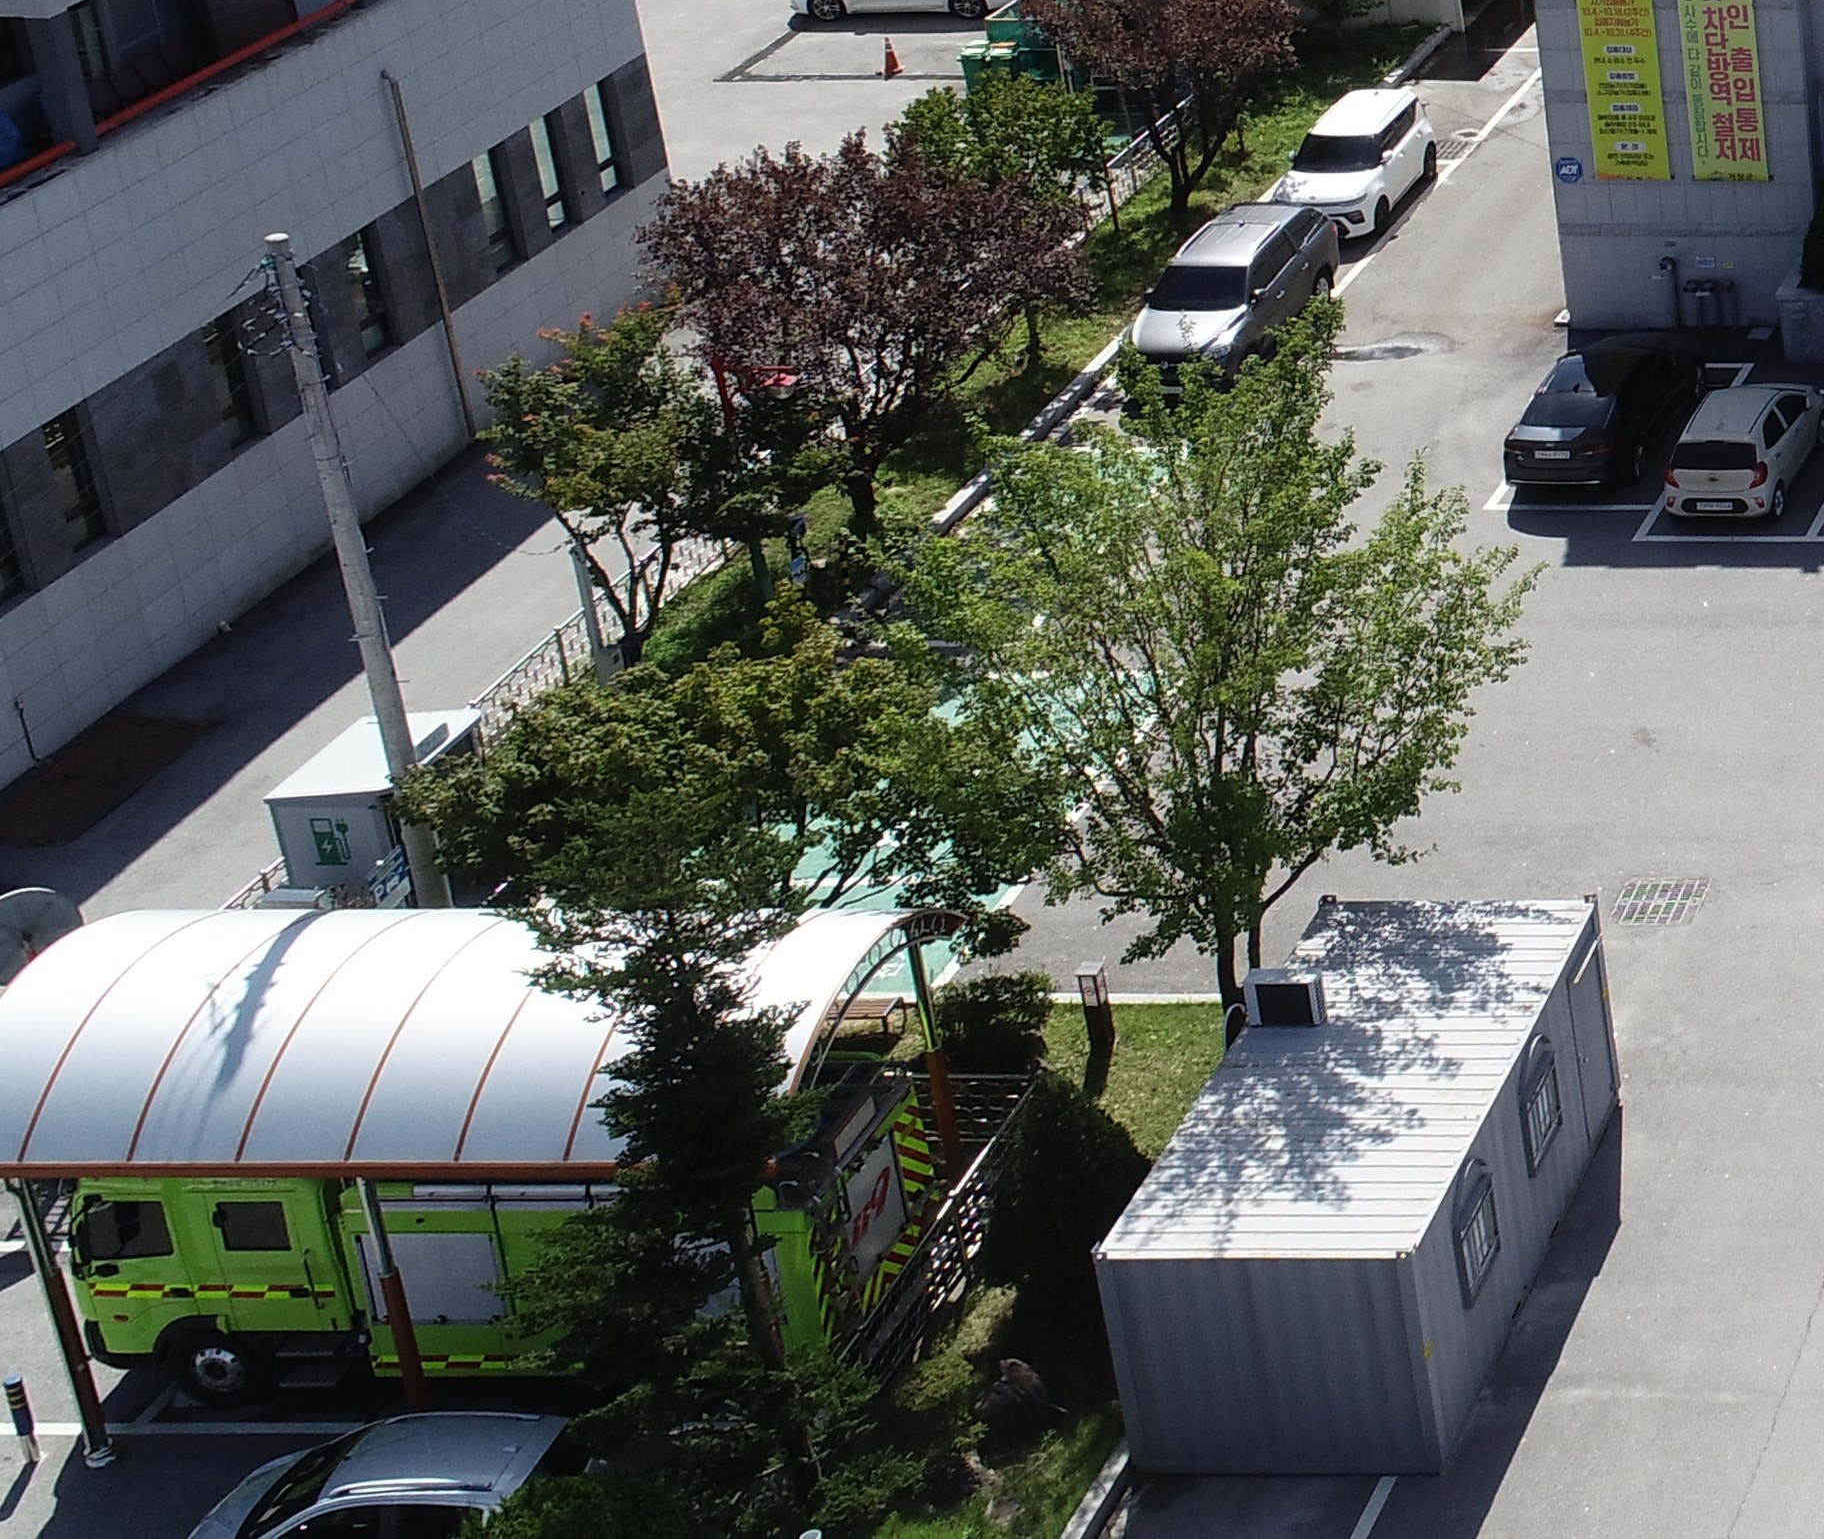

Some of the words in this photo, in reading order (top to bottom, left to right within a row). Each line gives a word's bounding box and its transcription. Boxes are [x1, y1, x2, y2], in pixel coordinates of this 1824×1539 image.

[1702, 7, 1732, 106] 차단방역
[1712, 112, 1737, 162] 철저
[1730, 47, 1761, 162] 출입통제
[1560, 164, 1578, 174] ADT
